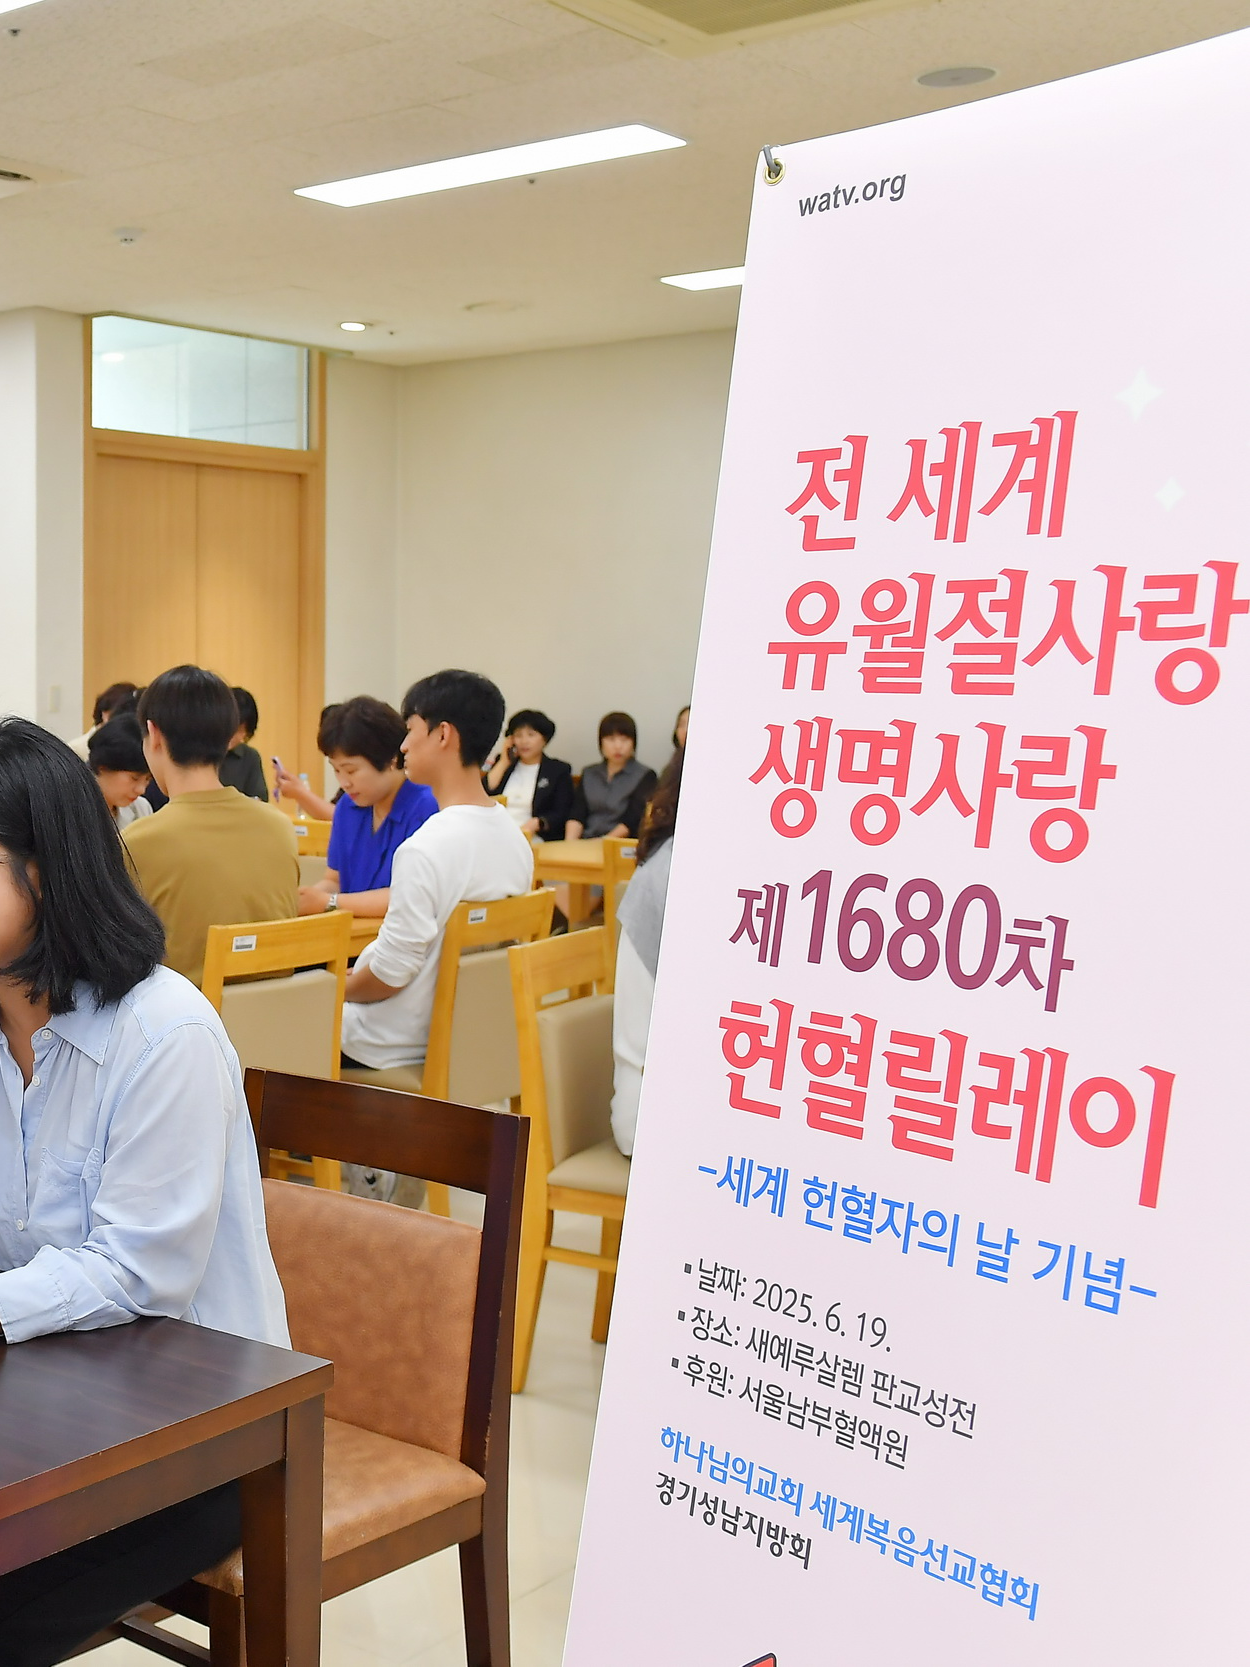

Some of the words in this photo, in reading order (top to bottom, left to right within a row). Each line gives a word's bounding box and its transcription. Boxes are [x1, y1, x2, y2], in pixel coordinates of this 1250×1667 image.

[798, 170, 907, 218] watv.org
[785, 435, 868, 552] 전
[886, 410, 1079, 544] 세계
[767, 560, 1250, 705] 유월절사랑
[748, 716, 1118, 863] 생명사랑
[729, 869, 1074, 1013] 제1680차
[718, 999, 1176, 1209] 헌혈릴레이
[698, 1155, 790, 1218] -세계
[802, 1175, 961, 1268] 헌혈자의
[975, 1222, 1020, 1284] 날
[1032, 1238, 1158, 1315] 기념-
[698, 1258, 747, 1302] 날짜:
[752, 1278, 817, 1328] 2025.
[825, 1302, 846, 1337] 6.
[856, 1312, 892, 1353] 19.
[682, 1354, 734, 1399] 후원:
[738, 1376, 909, 1470] 서울남부혈액원
[690, 1310, 740, 1348] 장소:
[744, 1328, 864, 1397] 새예루살렘
[870, 1369, 977, 1440] 판교성전
[656, 1471, 813, 1570] 경기성남지방회
[659, 1426, 803, 1518] 하나님의교회
[809, 1489, 1041, 1621] 세계복음선교협회
